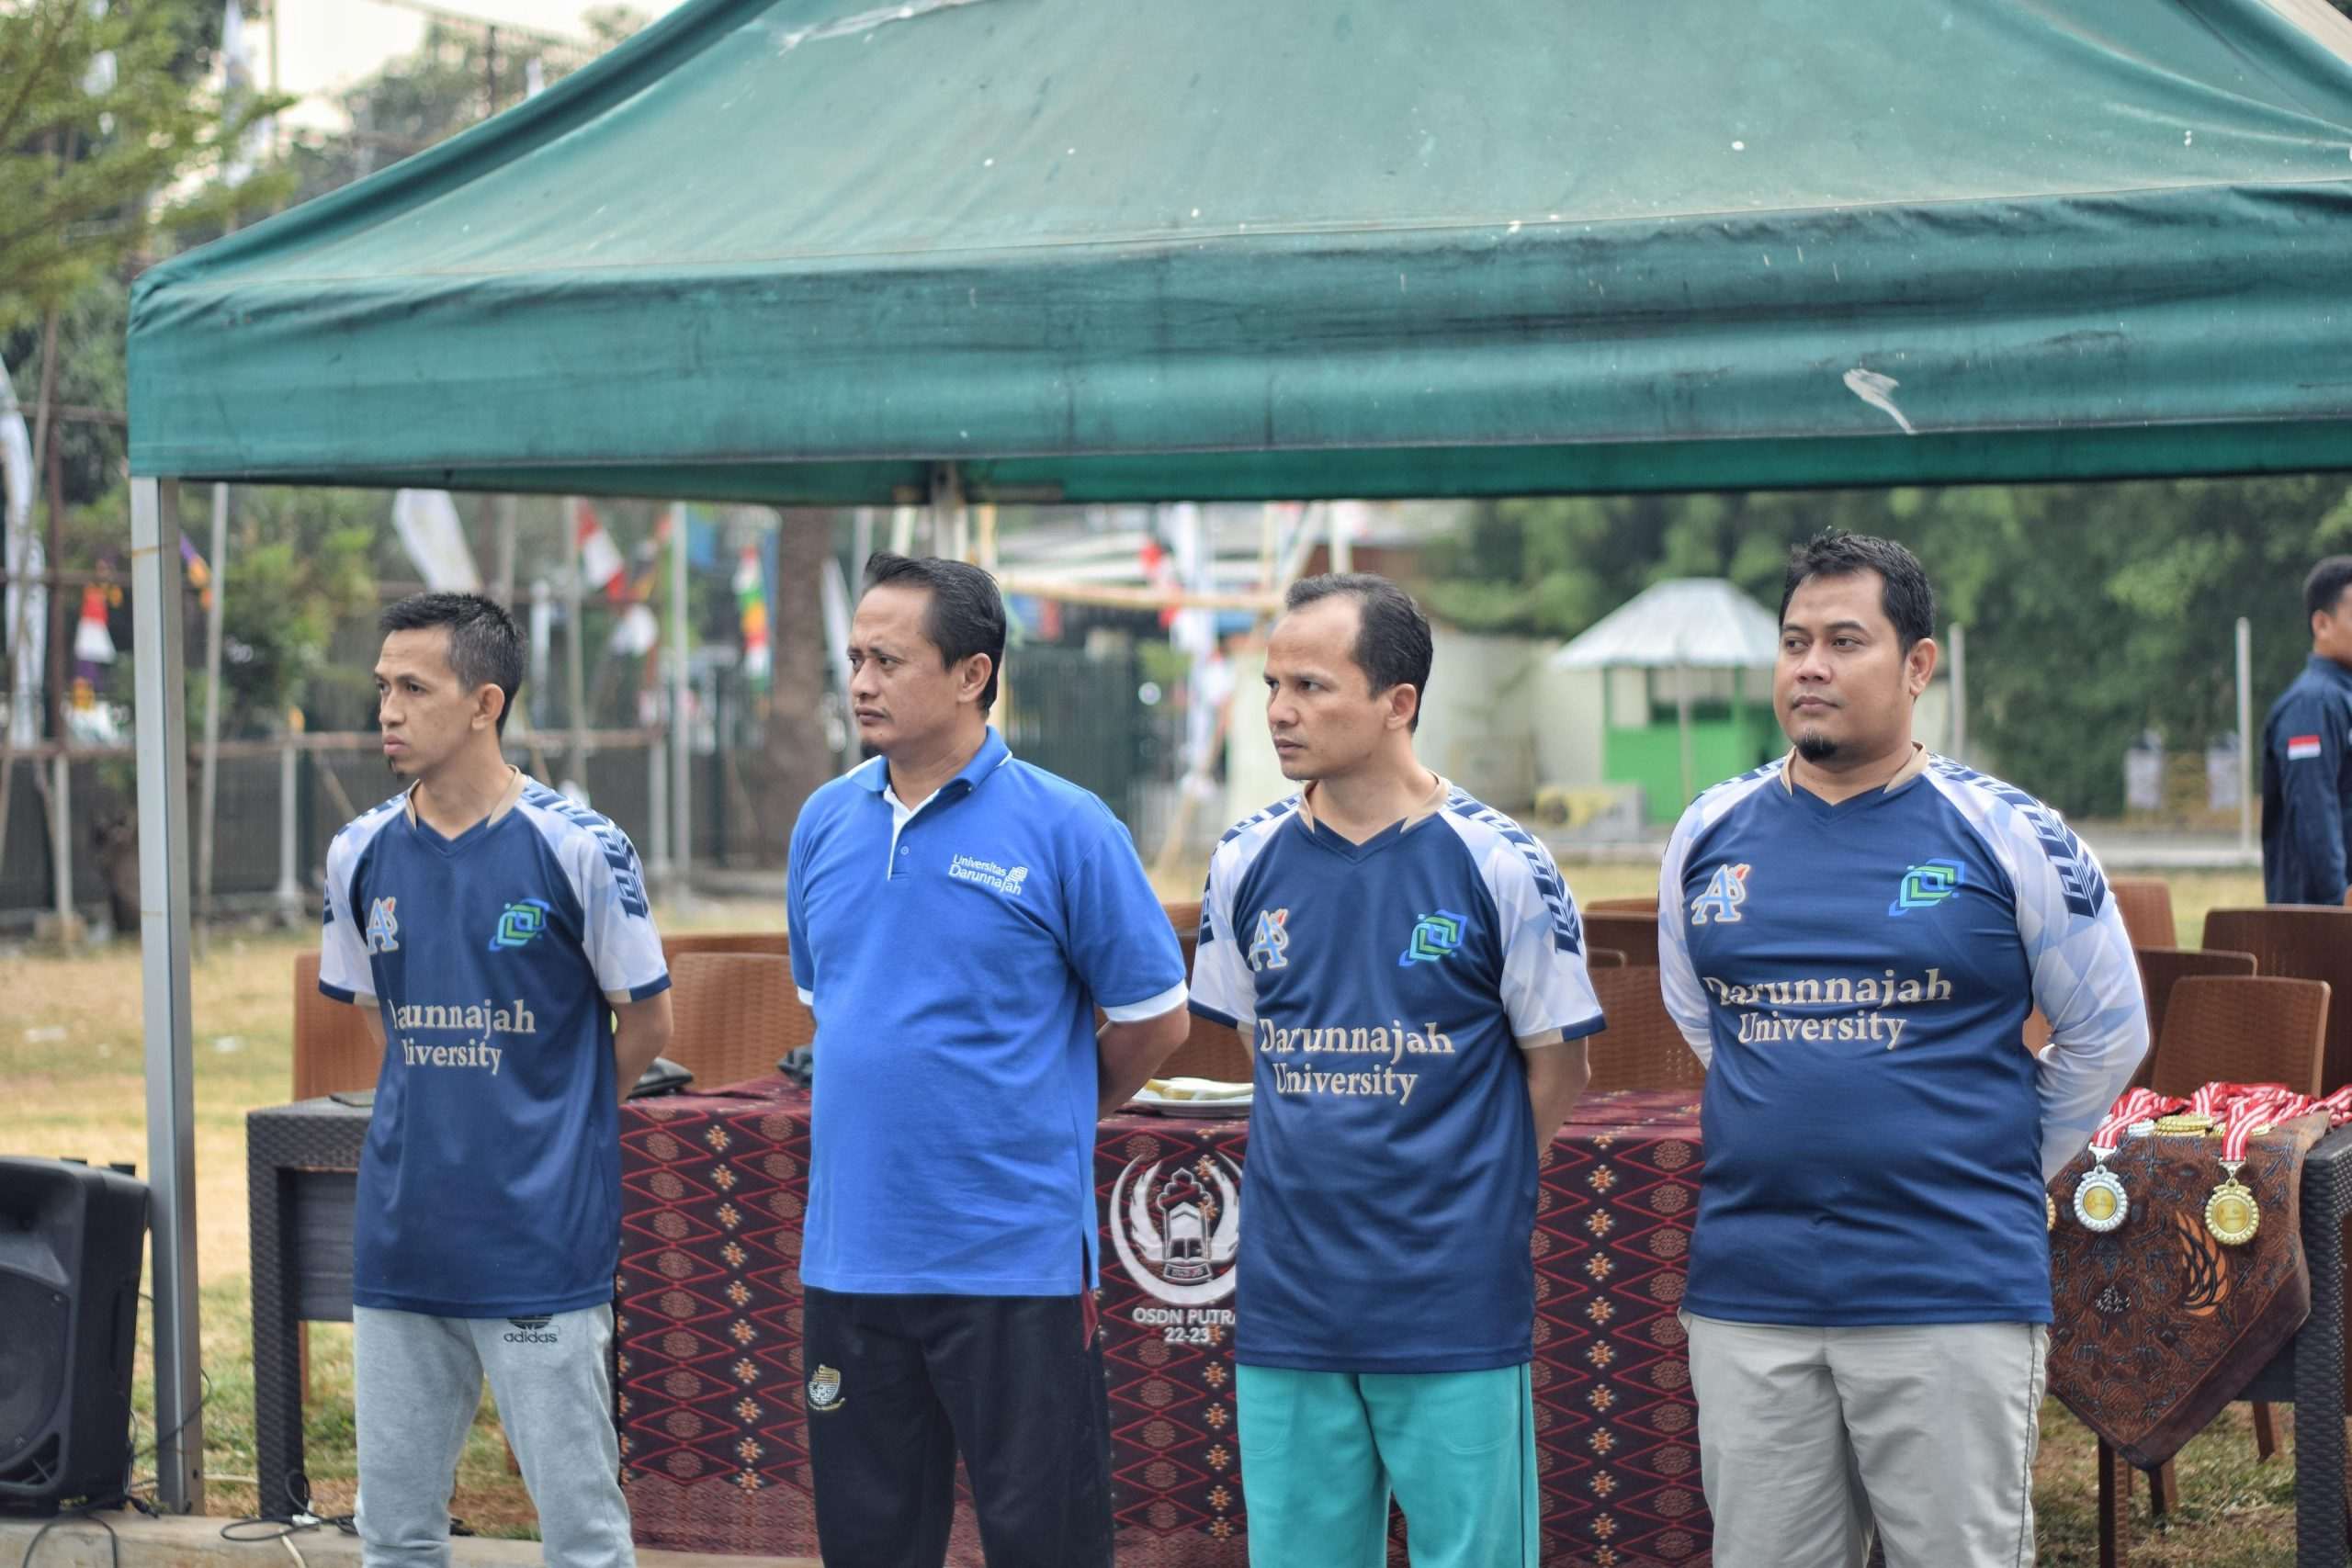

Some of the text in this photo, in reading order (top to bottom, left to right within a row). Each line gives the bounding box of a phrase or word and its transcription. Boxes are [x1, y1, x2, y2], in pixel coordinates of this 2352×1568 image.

[948, 863, 1022, 896] Darunnajah
[953, 853, 1007, 876] Universitas
[1702, 968, 1952, 1009] Darunnajah
[1259, 1018, 1455, 1065] Darunnajah
[1737, 1010, 1906, 1050] University
[1272, 1063, 1418, 1105] University
[1132, 1307, 1183, 1324] OSDN
[503, 1330, 558, 1343] adidas
[1163, 1326, 1210, 1343] 22-23
